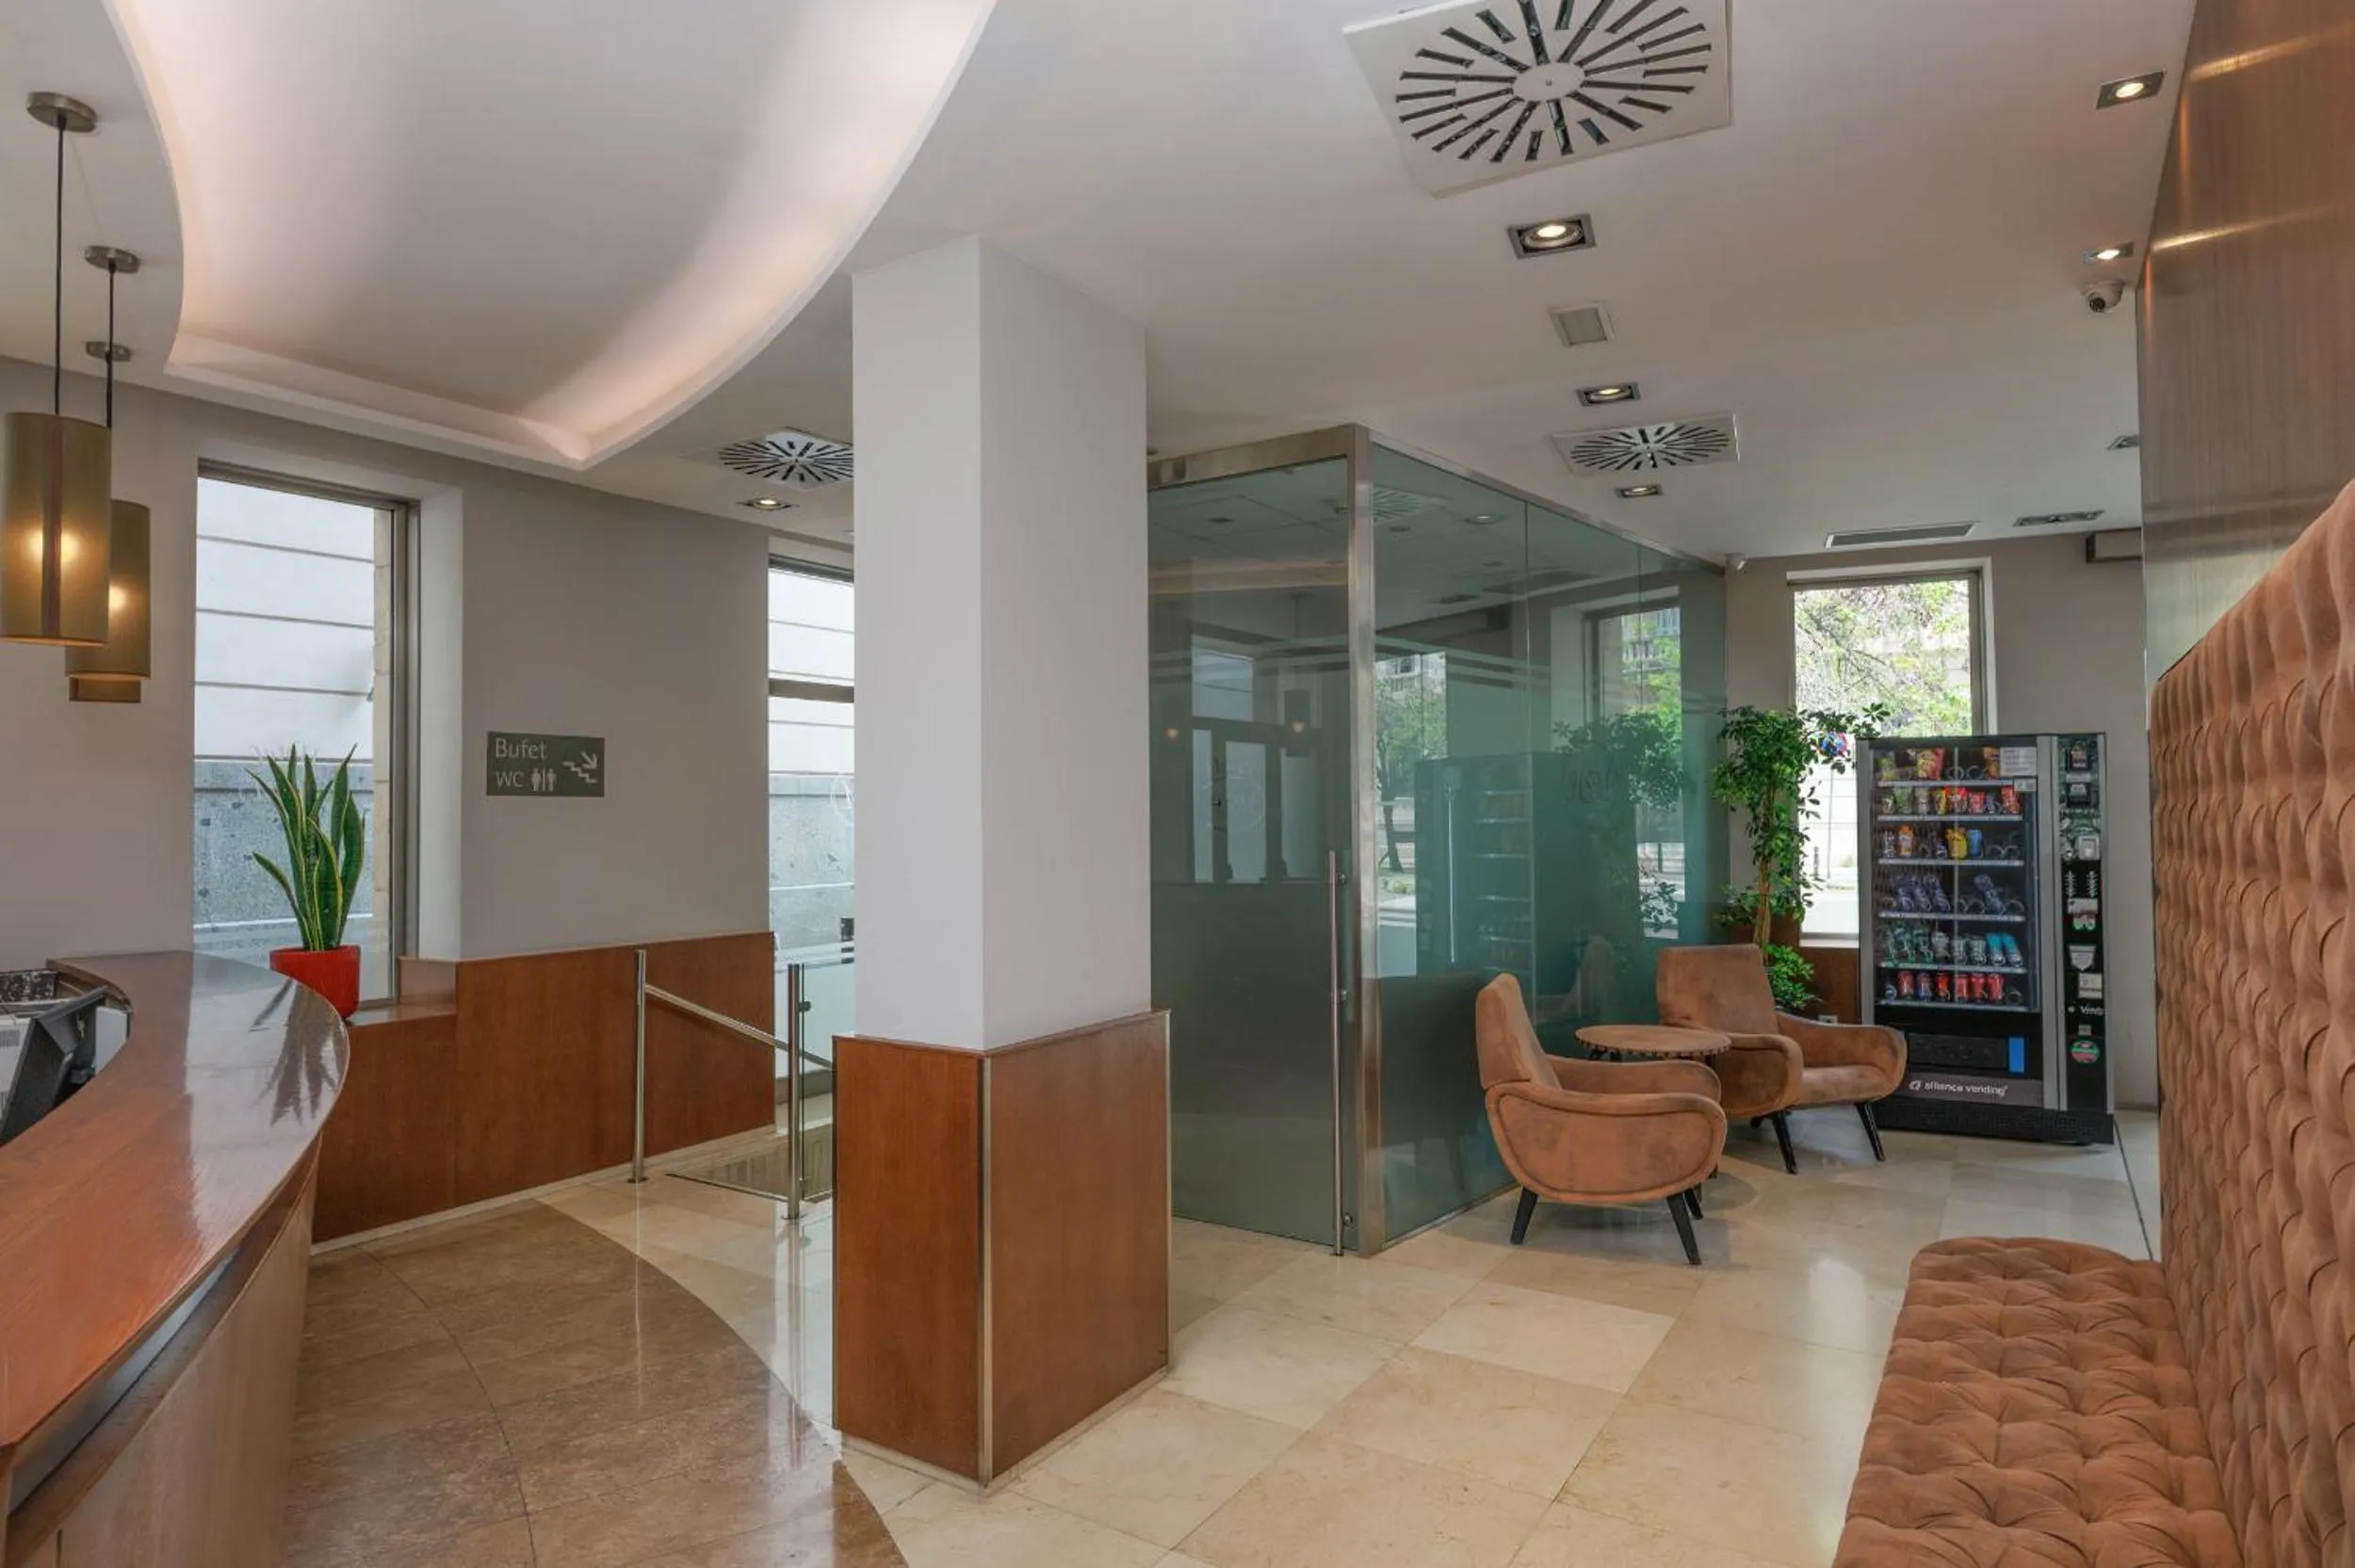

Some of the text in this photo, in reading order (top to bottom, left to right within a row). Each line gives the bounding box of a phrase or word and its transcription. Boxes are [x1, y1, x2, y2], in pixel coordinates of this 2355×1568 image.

[495, 737, 547, 760] Bufet
[495, 770, 524, 788] WC
[1925, 1081, 2007, 1097] alliance vending
